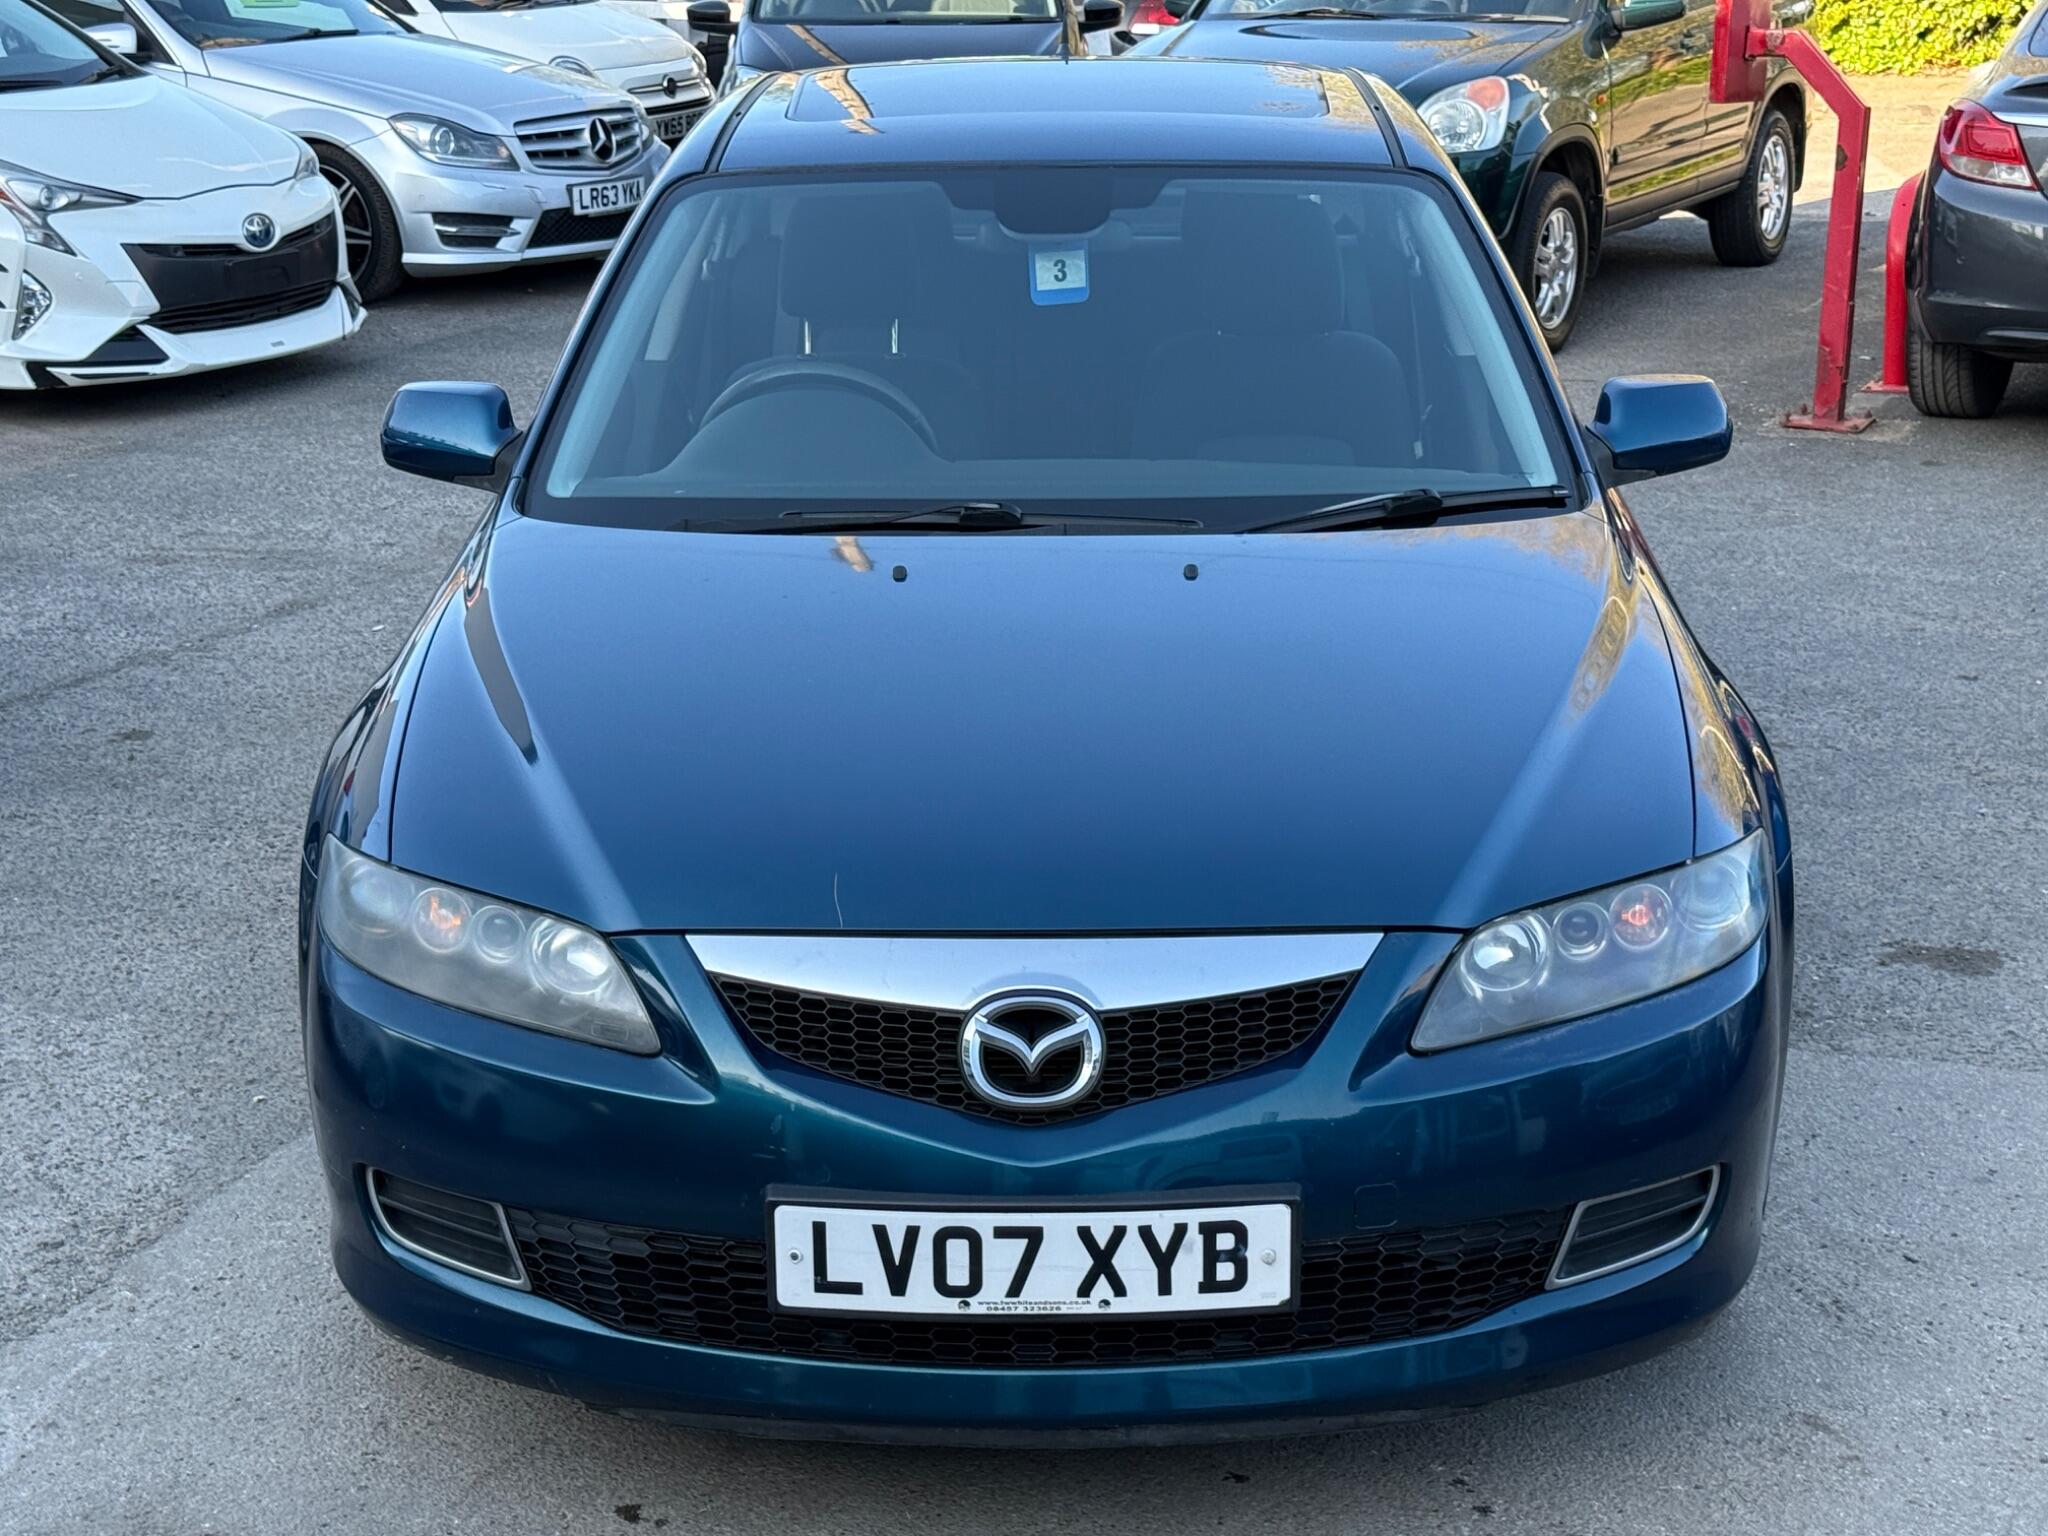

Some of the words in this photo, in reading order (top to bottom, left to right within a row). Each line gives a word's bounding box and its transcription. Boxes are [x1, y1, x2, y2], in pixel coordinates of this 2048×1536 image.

[579, 185, 619, 210] LR63
[622, 180, 642, 204] YKA
[1053, 258, 1067, 283] 3
[811, 1220, 1045, 1299] LV07
[1076, 1219, 1249, 1299] XYB
